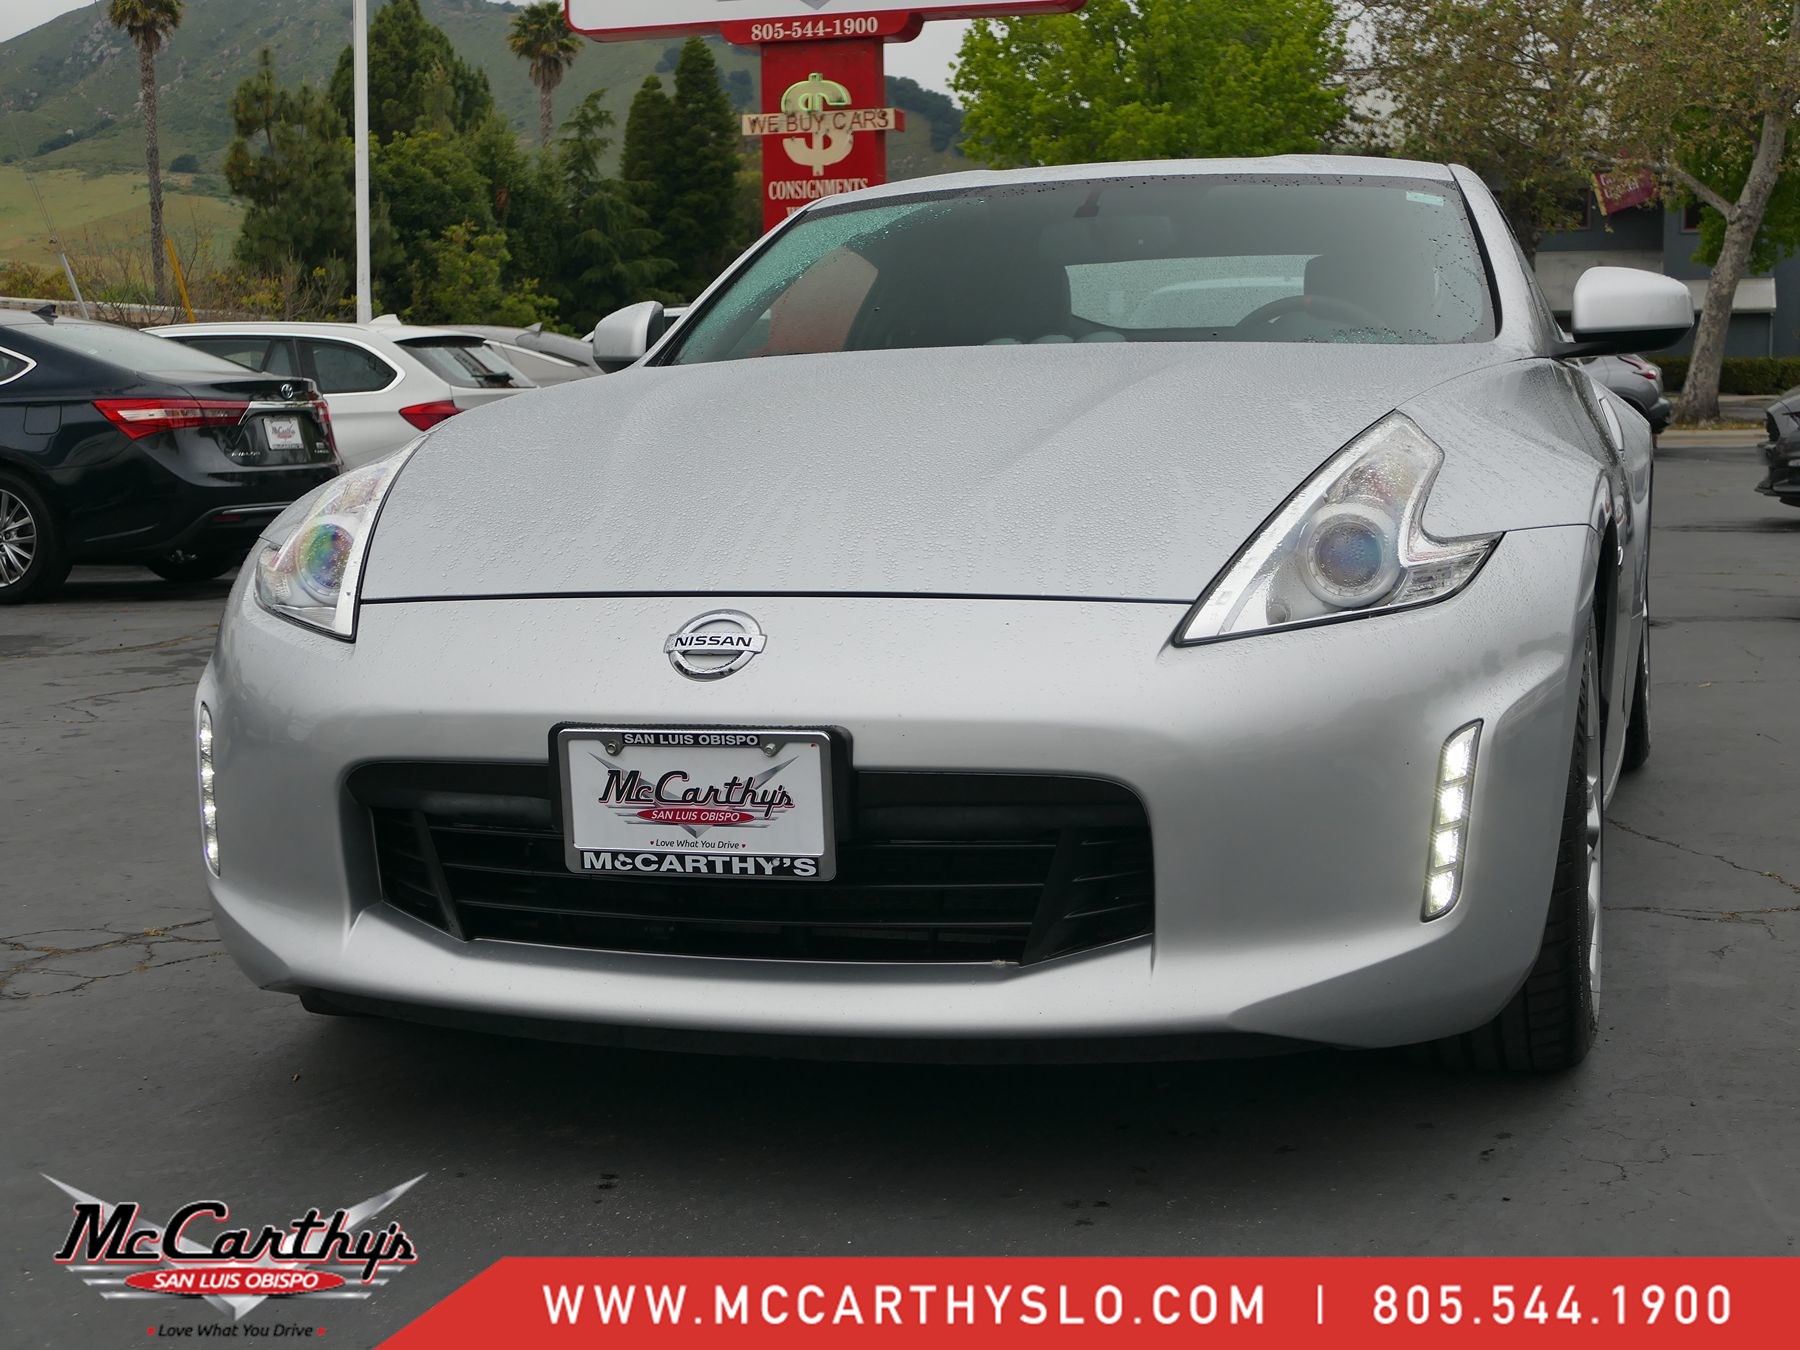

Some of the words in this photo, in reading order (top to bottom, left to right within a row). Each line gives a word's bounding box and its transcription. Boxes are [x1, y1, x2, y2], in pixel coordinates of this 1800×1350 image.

[751, 17, 878, 40] 805-544-1900
[748, 115, 778, 133] WE
[786, 113, 825, 132] BUY
[833, 110, 889, 130] CARS
[674, 636, 752, 647] NISSAN
[624, 734, 655, 745] SAN
[659, 735, 694, 745] LUIS
[698, 735, 759, 746] OBISPO
[599, 769, 796, 820] McCarthy's
[651, 810, 674, 819] SAN
[676, 811, 697, 820] LUIS
[700, 812, 740, 822] OBISPO
[656, 839, 675, 847] Love
[676, 839, 698, 848] What
[701, 840, 718, 849] You
[718, 841, 740, 849] Drive
